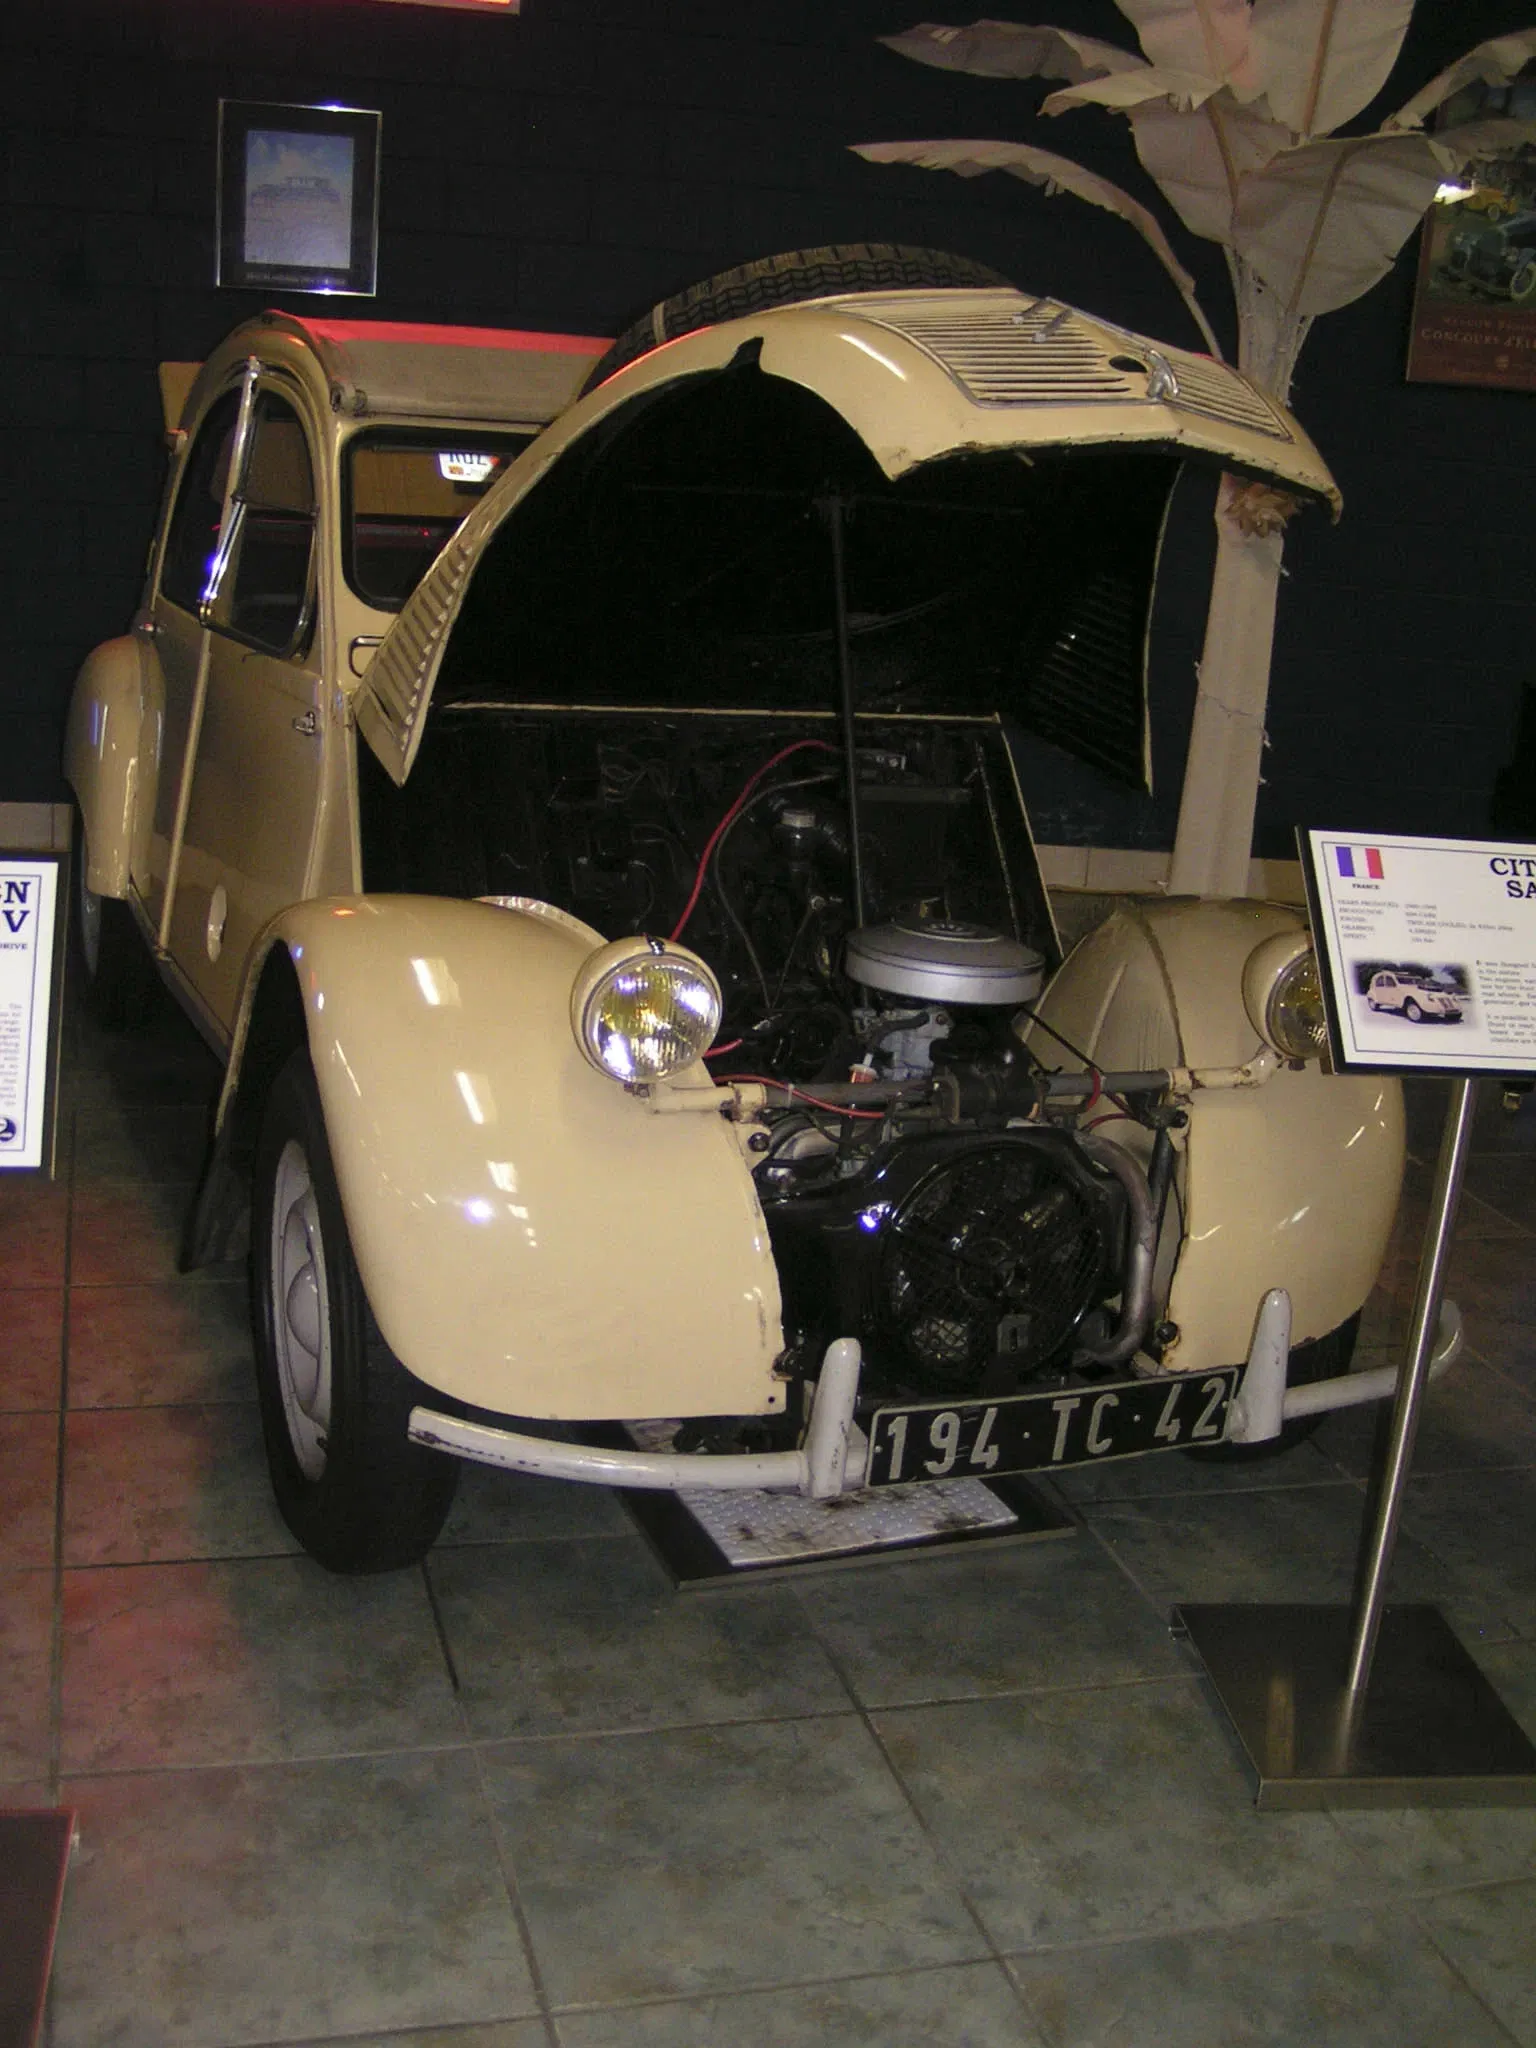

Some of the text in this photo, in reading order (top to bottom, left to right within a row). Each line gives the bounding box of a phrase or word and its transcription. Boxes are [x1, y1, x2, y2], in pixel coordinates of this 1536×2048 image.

[887, 1377, 1226, 1480] 194 TC 42
